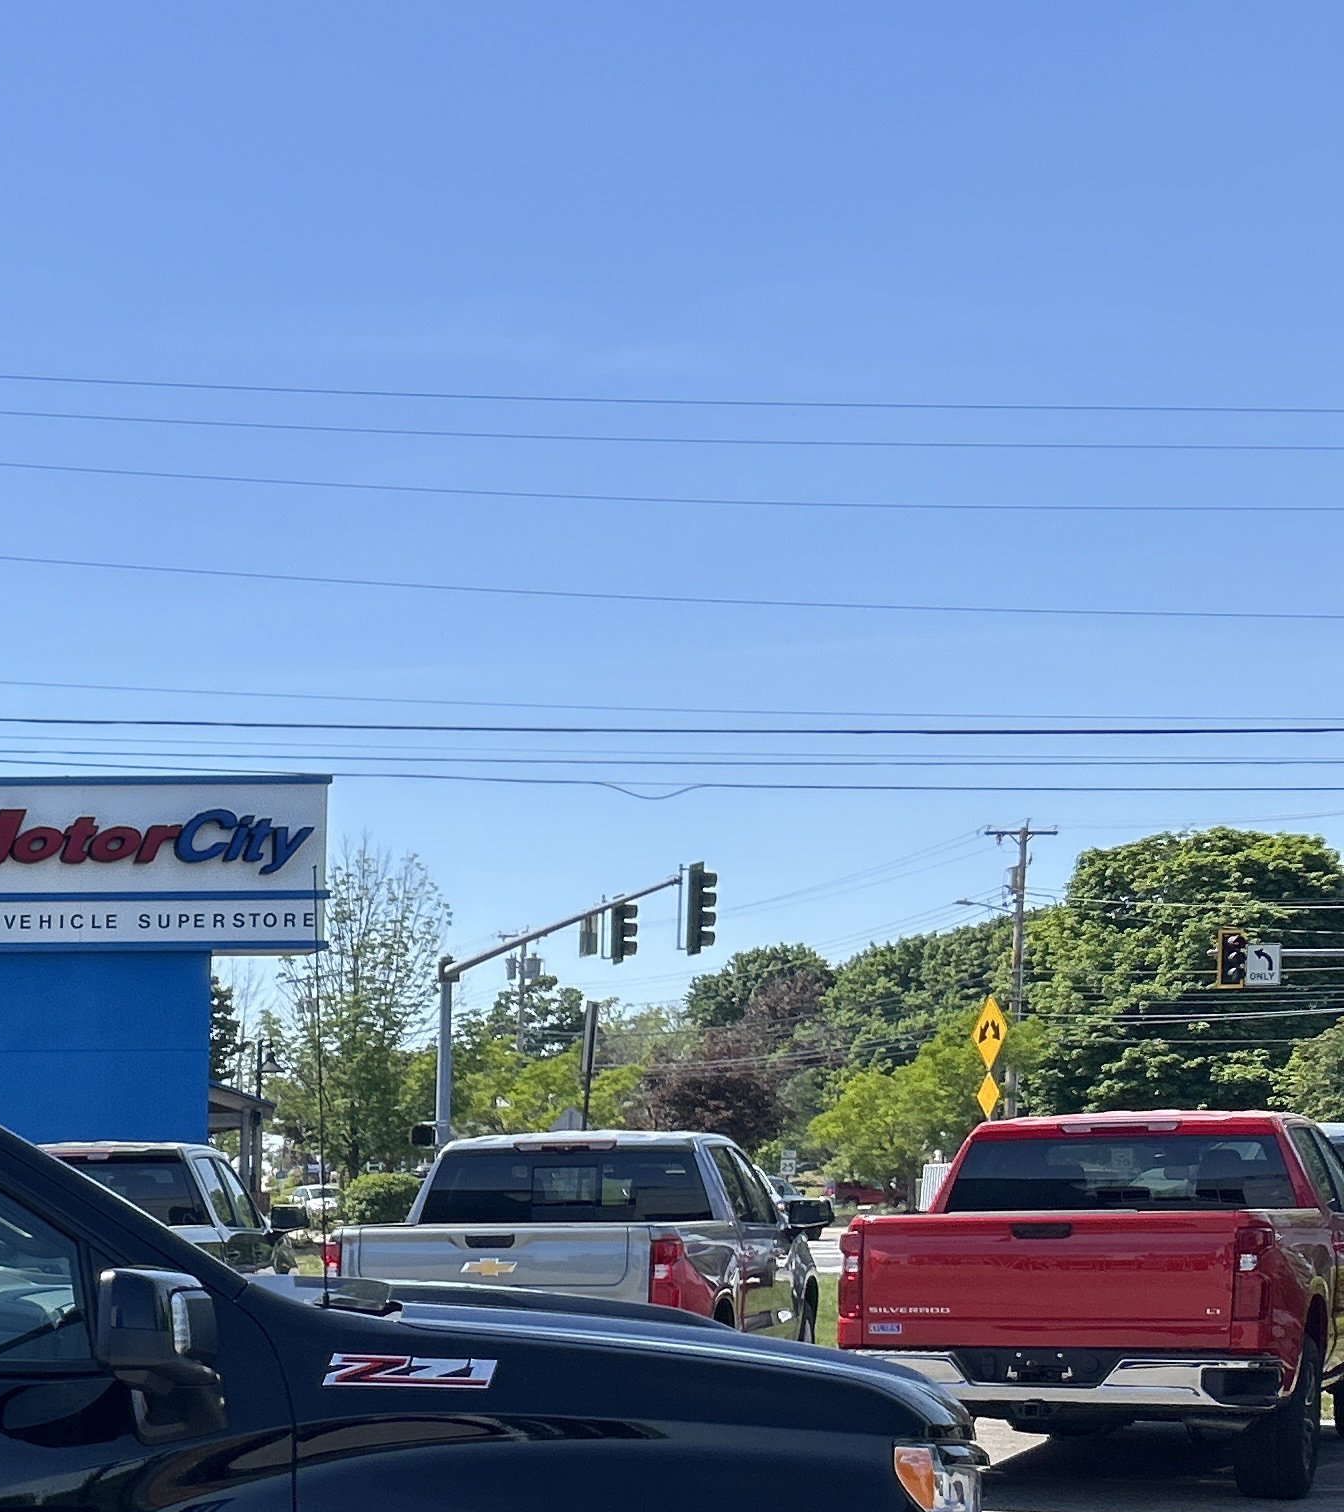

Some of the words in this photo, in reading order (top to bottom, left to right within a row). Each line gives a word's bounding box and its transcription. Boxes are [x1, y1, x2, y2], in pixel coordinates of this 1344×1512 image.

[3, 914, 118, 930] VEHICLE
[137, 912, 315, 930] SUPERSTORE
[1249, 971, 1276, 981] ONLY
[322, 1353, 498, 1389] Z71
